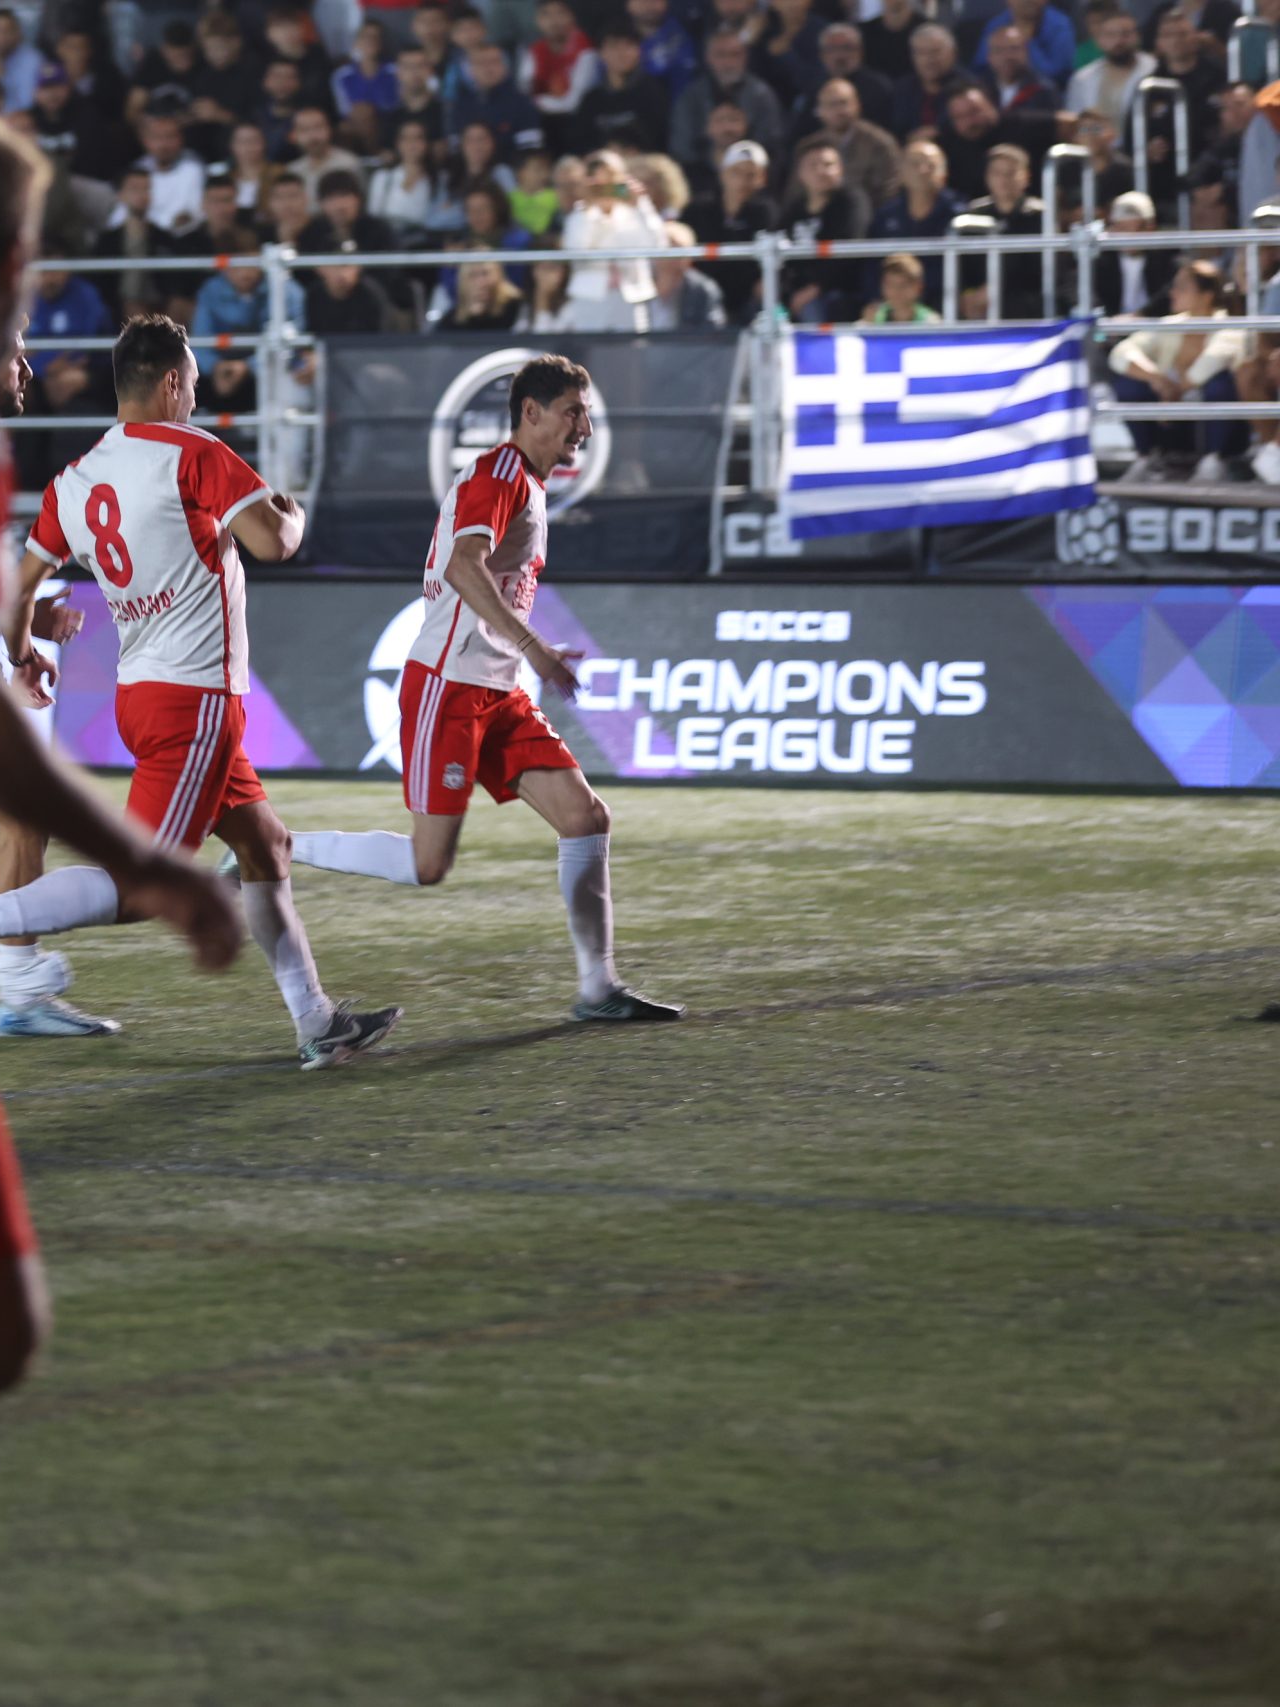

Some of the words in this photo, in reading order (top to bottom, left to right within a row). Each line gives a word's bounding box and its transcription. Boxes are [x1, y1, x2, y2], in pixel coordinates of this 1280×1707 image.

[85, 483, 133, 589] 8
[577, 657, 987, 716] CHAMPIONS
[633, 716, 916, 773] LEAGUE
